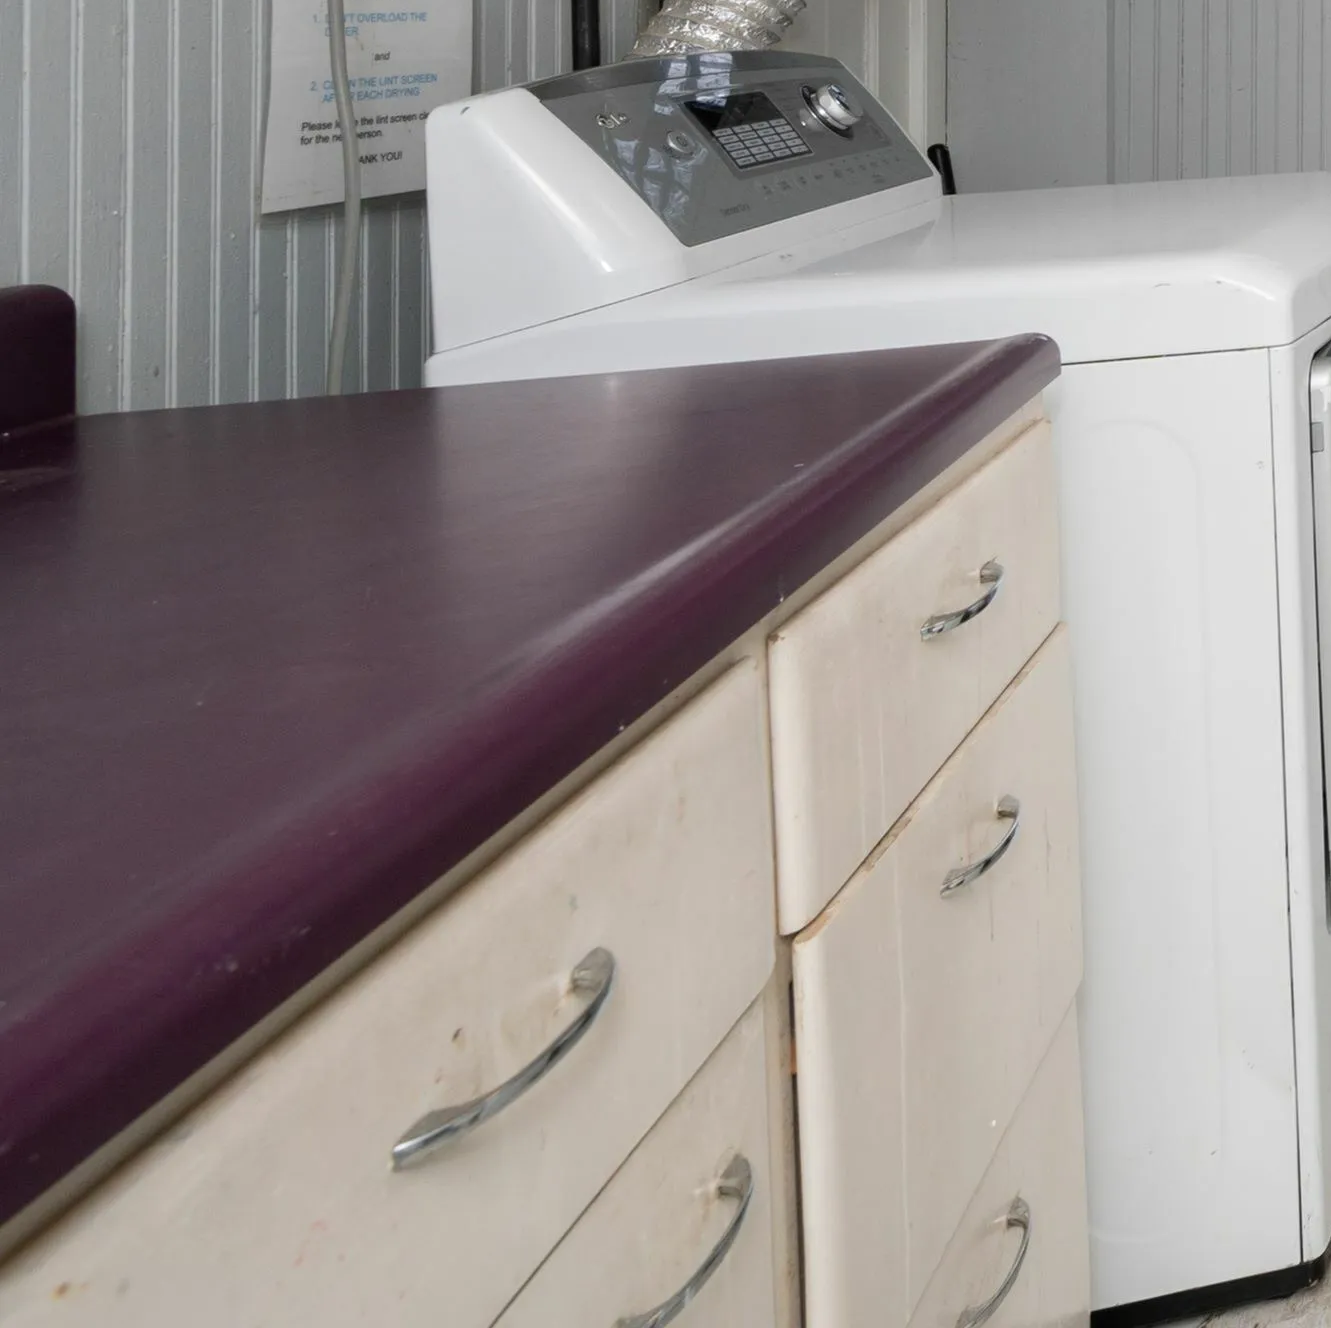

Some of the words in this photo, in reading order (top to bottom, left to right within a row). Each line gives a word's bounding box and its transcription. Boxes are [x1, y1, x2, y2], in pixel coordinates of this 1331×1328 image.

[357, 12, 408, 24] OVERLOAD
[410, 11, 427, 22] THE
[374, 52, 391, 61] and
[360, 76, 377, 87] THE
[379, 75, 399, 86] LINT
[401, 73, 438, 85] SCREEN
[357, 90, 383, 101] EACH
[385, 86, 420, 99] DRYING
[302, 121, 333, 131] Please
[361, 116, 374, 126] the
[376, 114, 388, 124] lint
[390, 112, 417, 124] screen
[300, 136, 313, 146] for
[315, 134, 330, 144] the
[381, 151, 403, 162] YOU!
